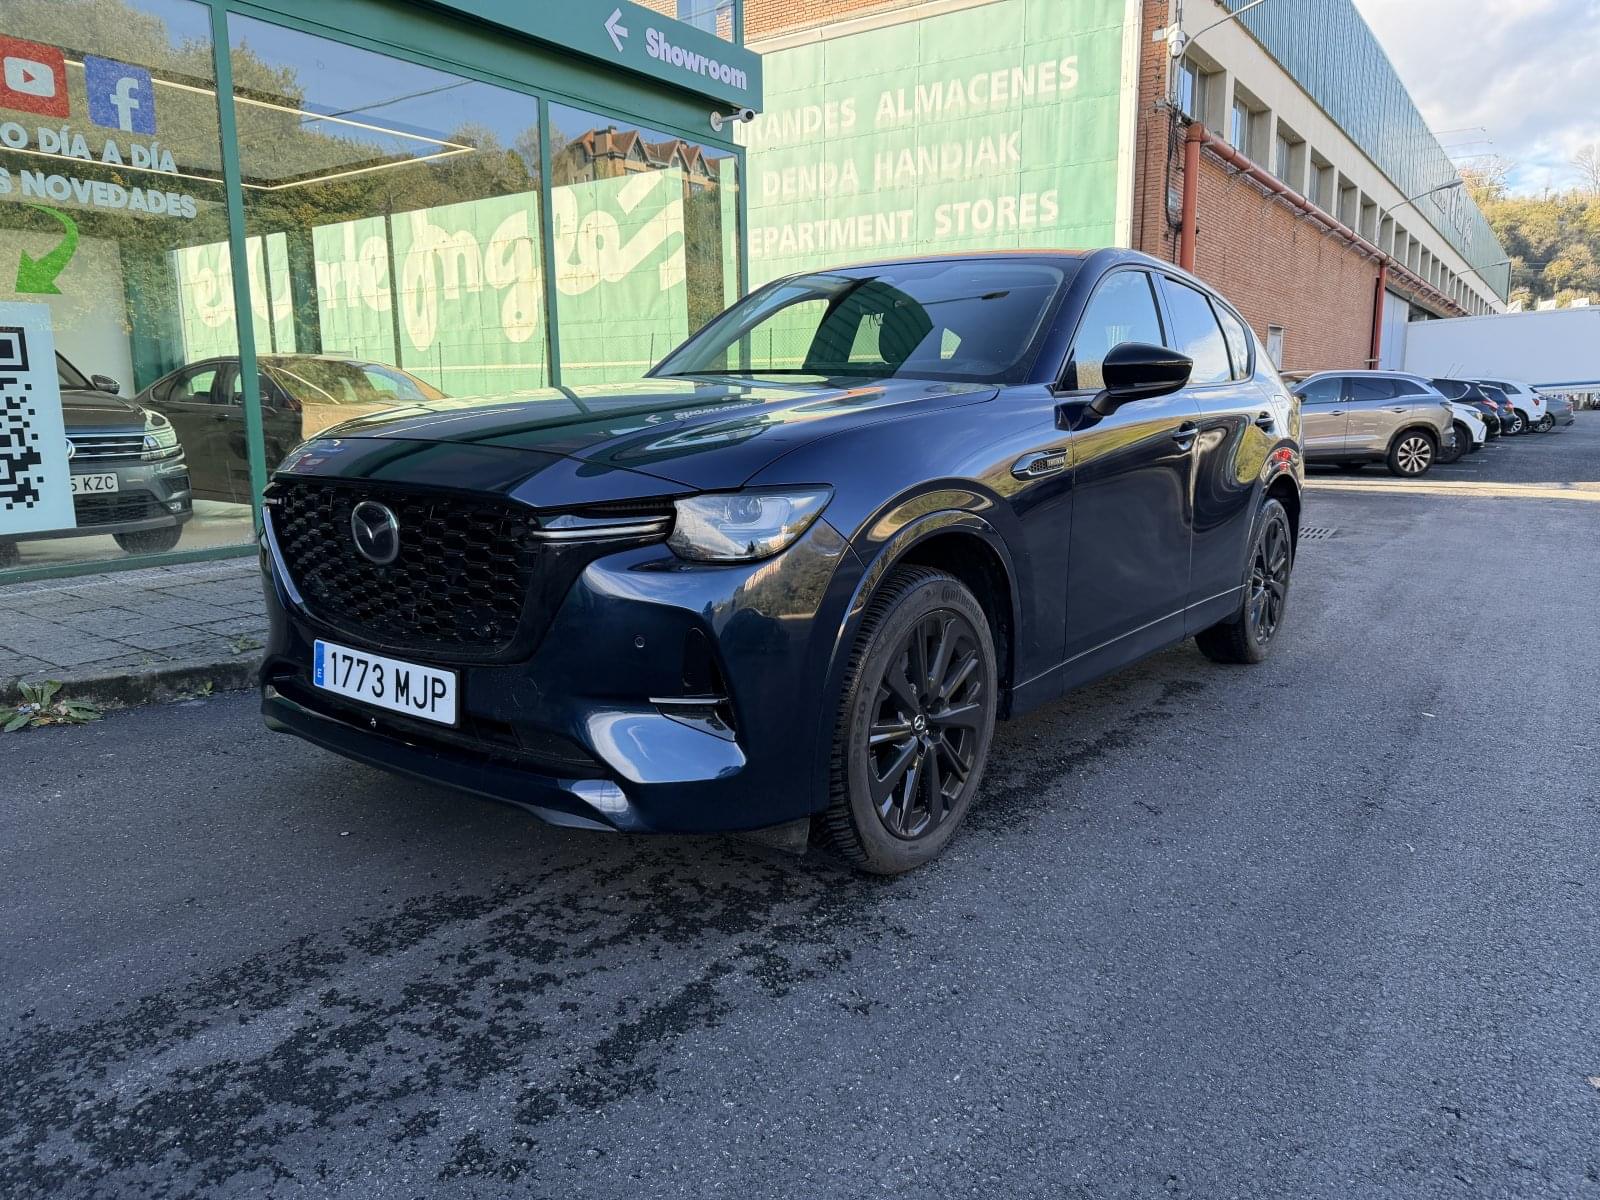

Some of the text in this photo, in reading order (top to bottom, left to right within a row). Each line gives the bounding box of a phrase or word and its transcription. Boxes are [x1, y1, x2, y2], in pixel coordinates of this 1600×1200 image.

[645, 27, 747, 91] Showroom
[741, 55, 1080, 145] RANDES ALMACENES
[37, 125, 92, 161] DÍA
[101, 139, 124, 166] A
[131, 141, 178, 174] DÍA
[761, 131, 1022, 198] DENDA HANDIAK
[20, 169, 197, 219] NOVEDADES
[748, 189, 1059, 257] EPARTMENT STORES
[83, 475, 115, 491] KZC
[331, 651, 385, 698] 1773
[395, 667, 447, 713] MJP
